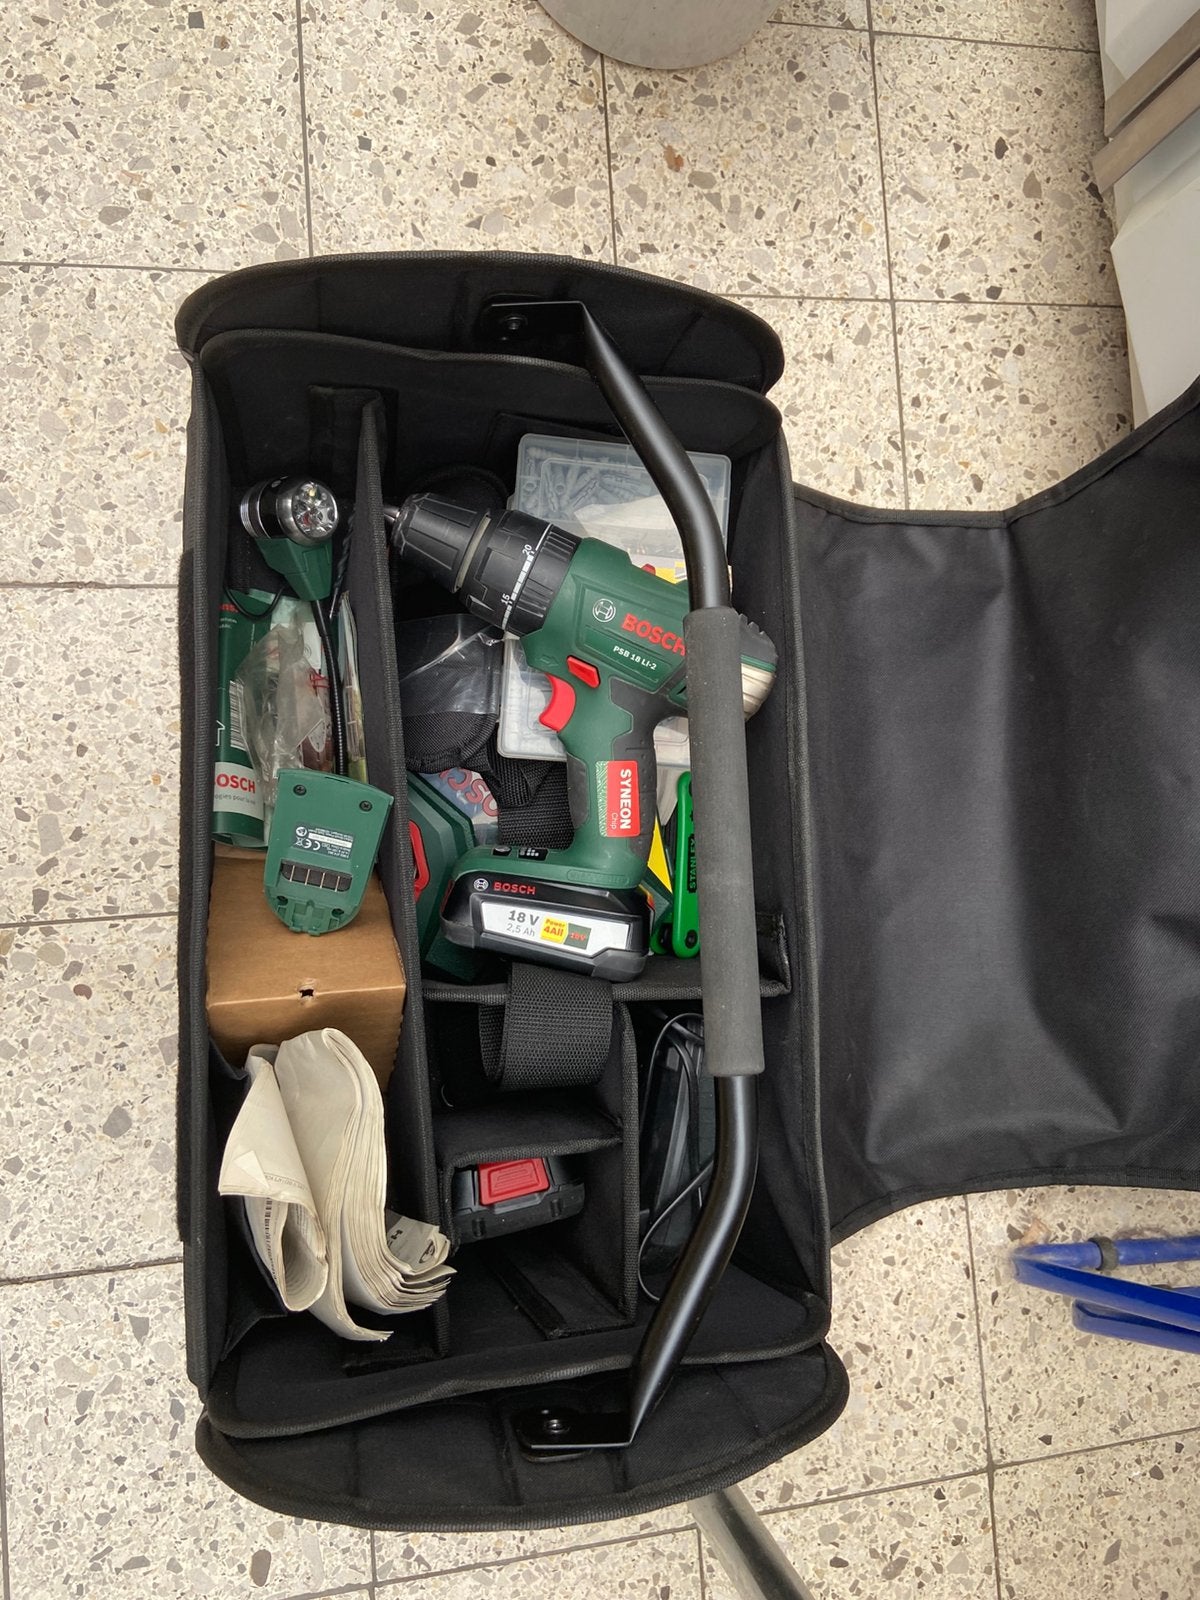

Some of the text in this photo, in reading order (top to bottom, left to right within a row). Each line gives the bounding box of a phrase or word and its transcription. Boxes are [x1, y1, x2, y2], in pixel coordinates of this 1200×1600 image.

[522, 544, 532, 556] 20
[500, 593, 510, 605] 15
[622, 613, 686, 656] BOSCH
[613, 645, 630, 657] PSB
[630, 654, 641, 663] 18
[216, 773, 256, 794] OSCH
[439, 767, 499, 817] OSC
[620, 768, 632, 829] SYNEON
[610, 812, 618, 829] Chip
[493, 882, 536, 895] BOSCH
[508, 910, 540, 926] 18 V
[545, 918, 566, 928] Power
[523, 926, 536, 937] Ah
[543, 926, 565, 938] 4All
